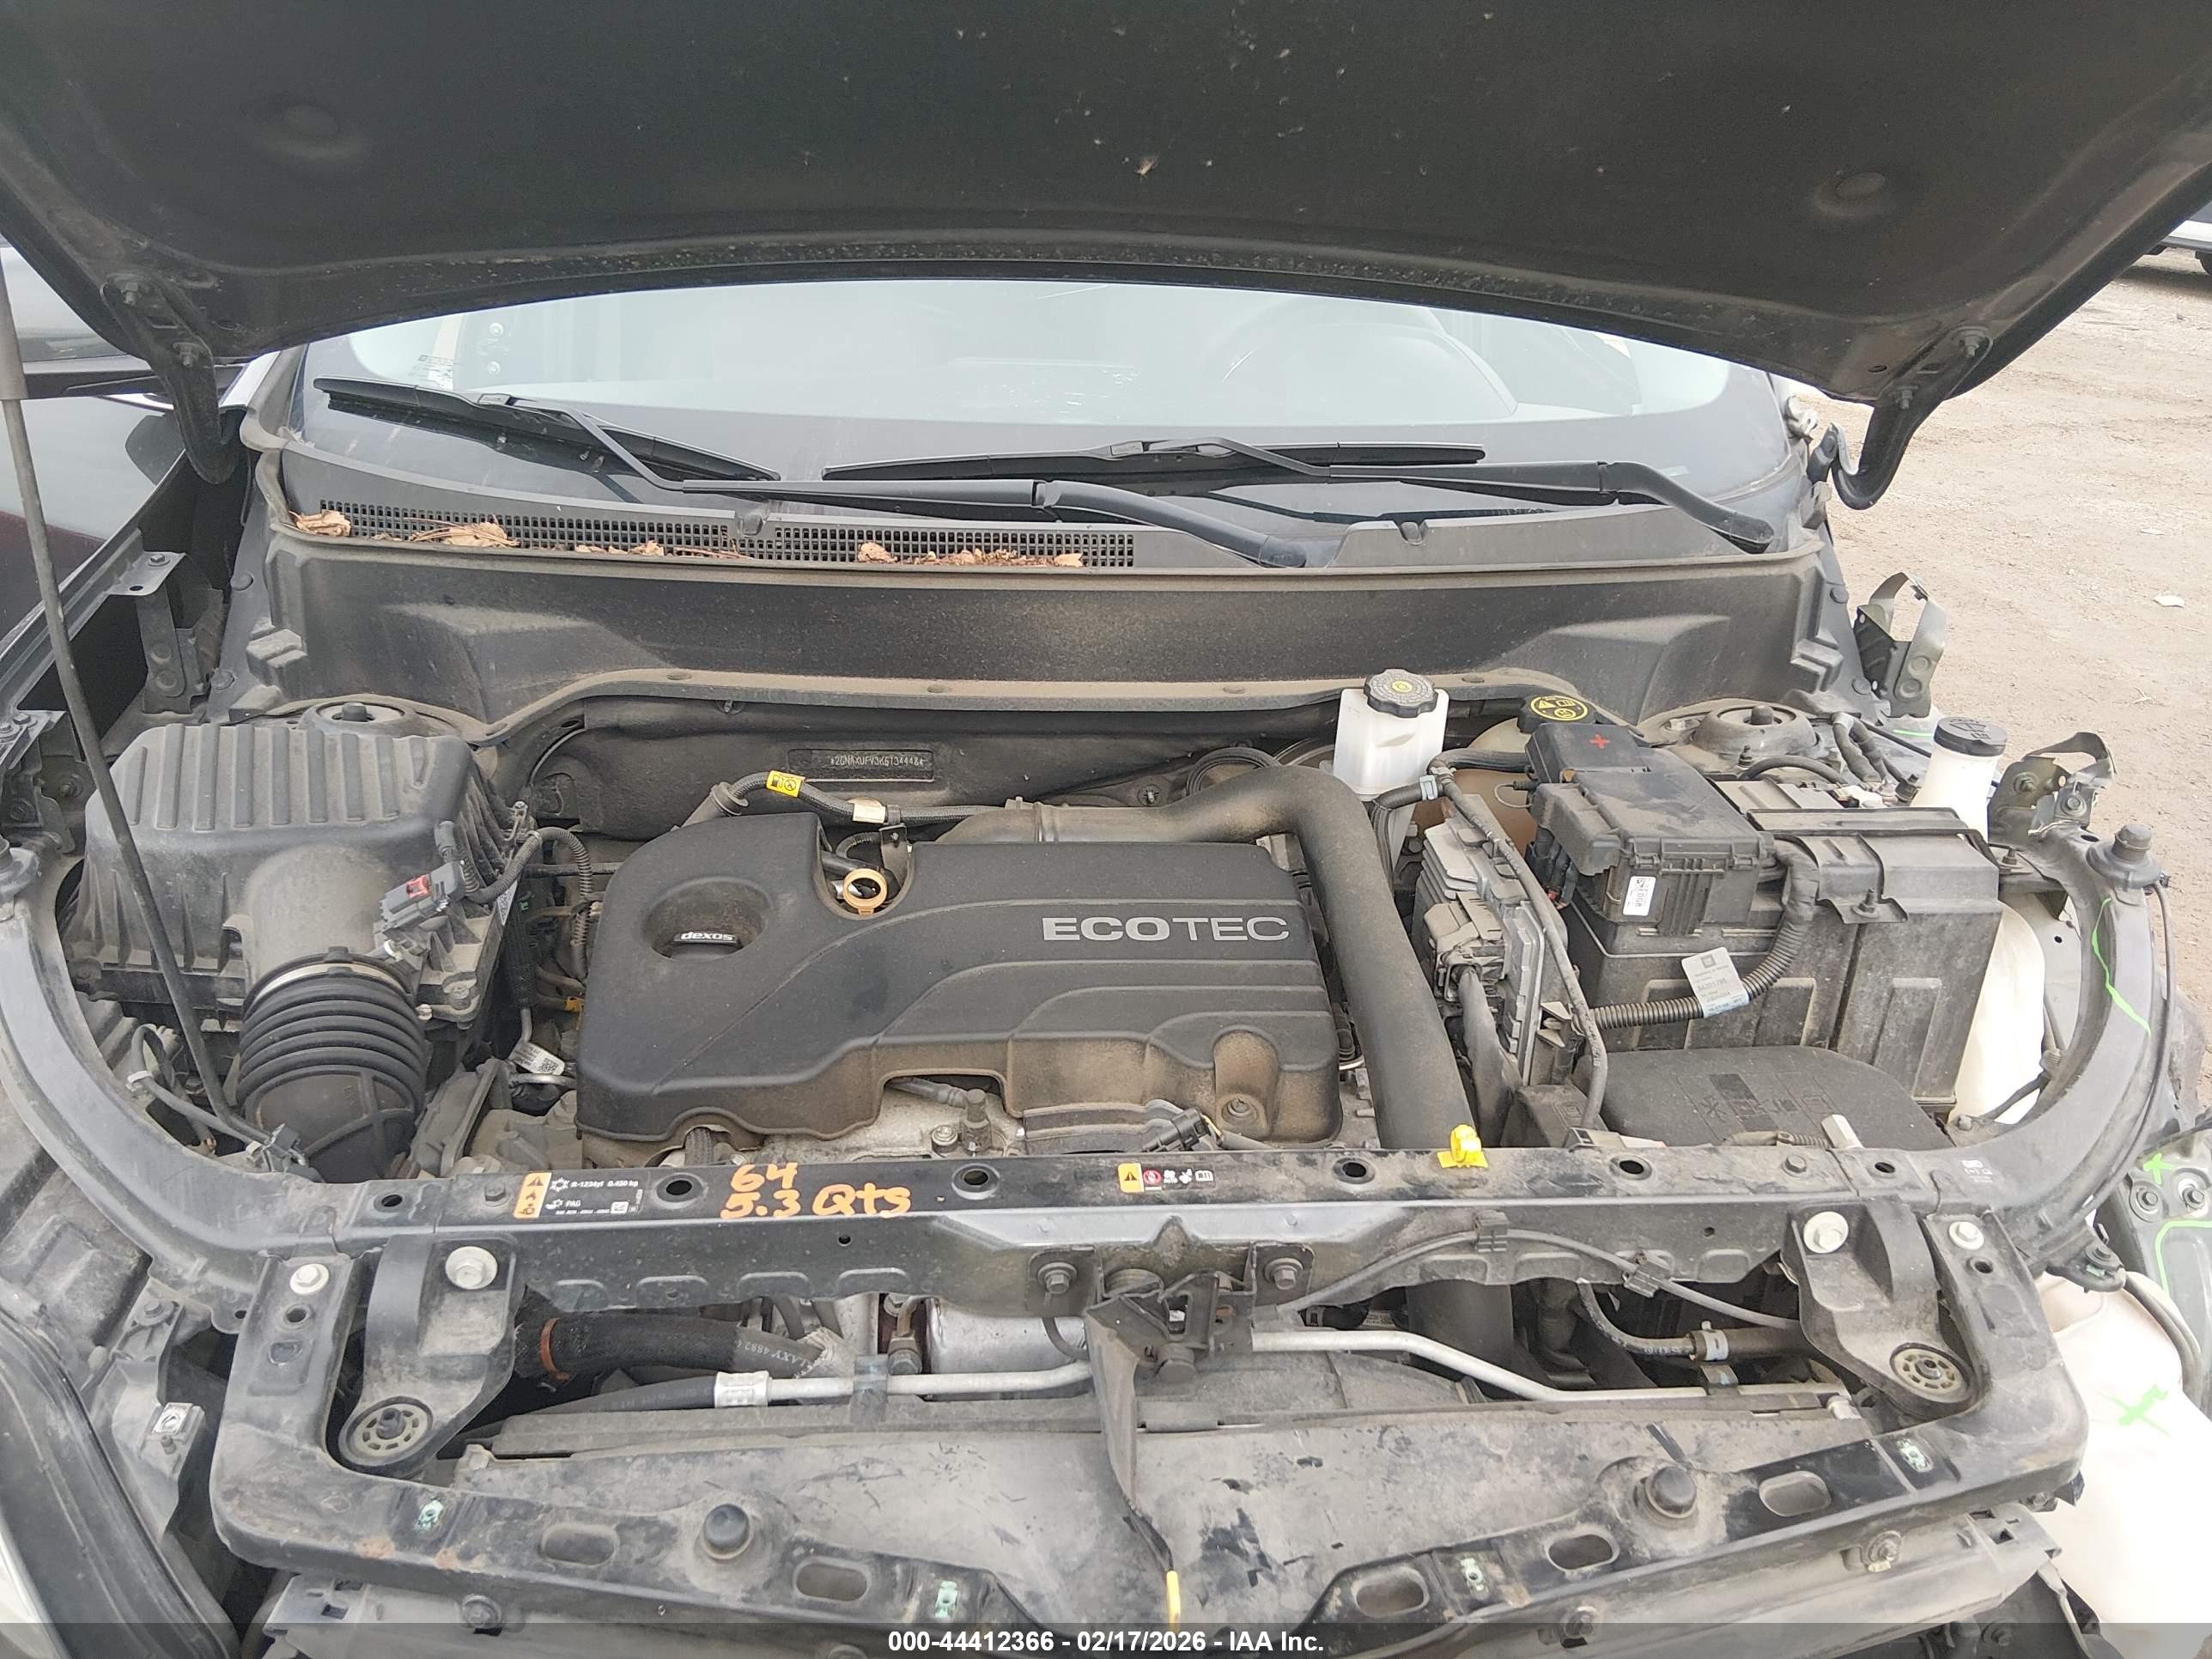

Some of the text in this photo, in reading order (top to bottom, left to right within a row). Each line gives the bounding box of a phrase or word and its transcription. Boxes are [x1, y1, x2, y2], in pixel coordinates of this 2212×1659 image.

[680, 932, 736, 941] dexos
[1042, 916, 1290, 941] ECOTEC
[729, 1162, 799, 1193] 64
[720, 1182, 911, 1219] 5.3 Qts
